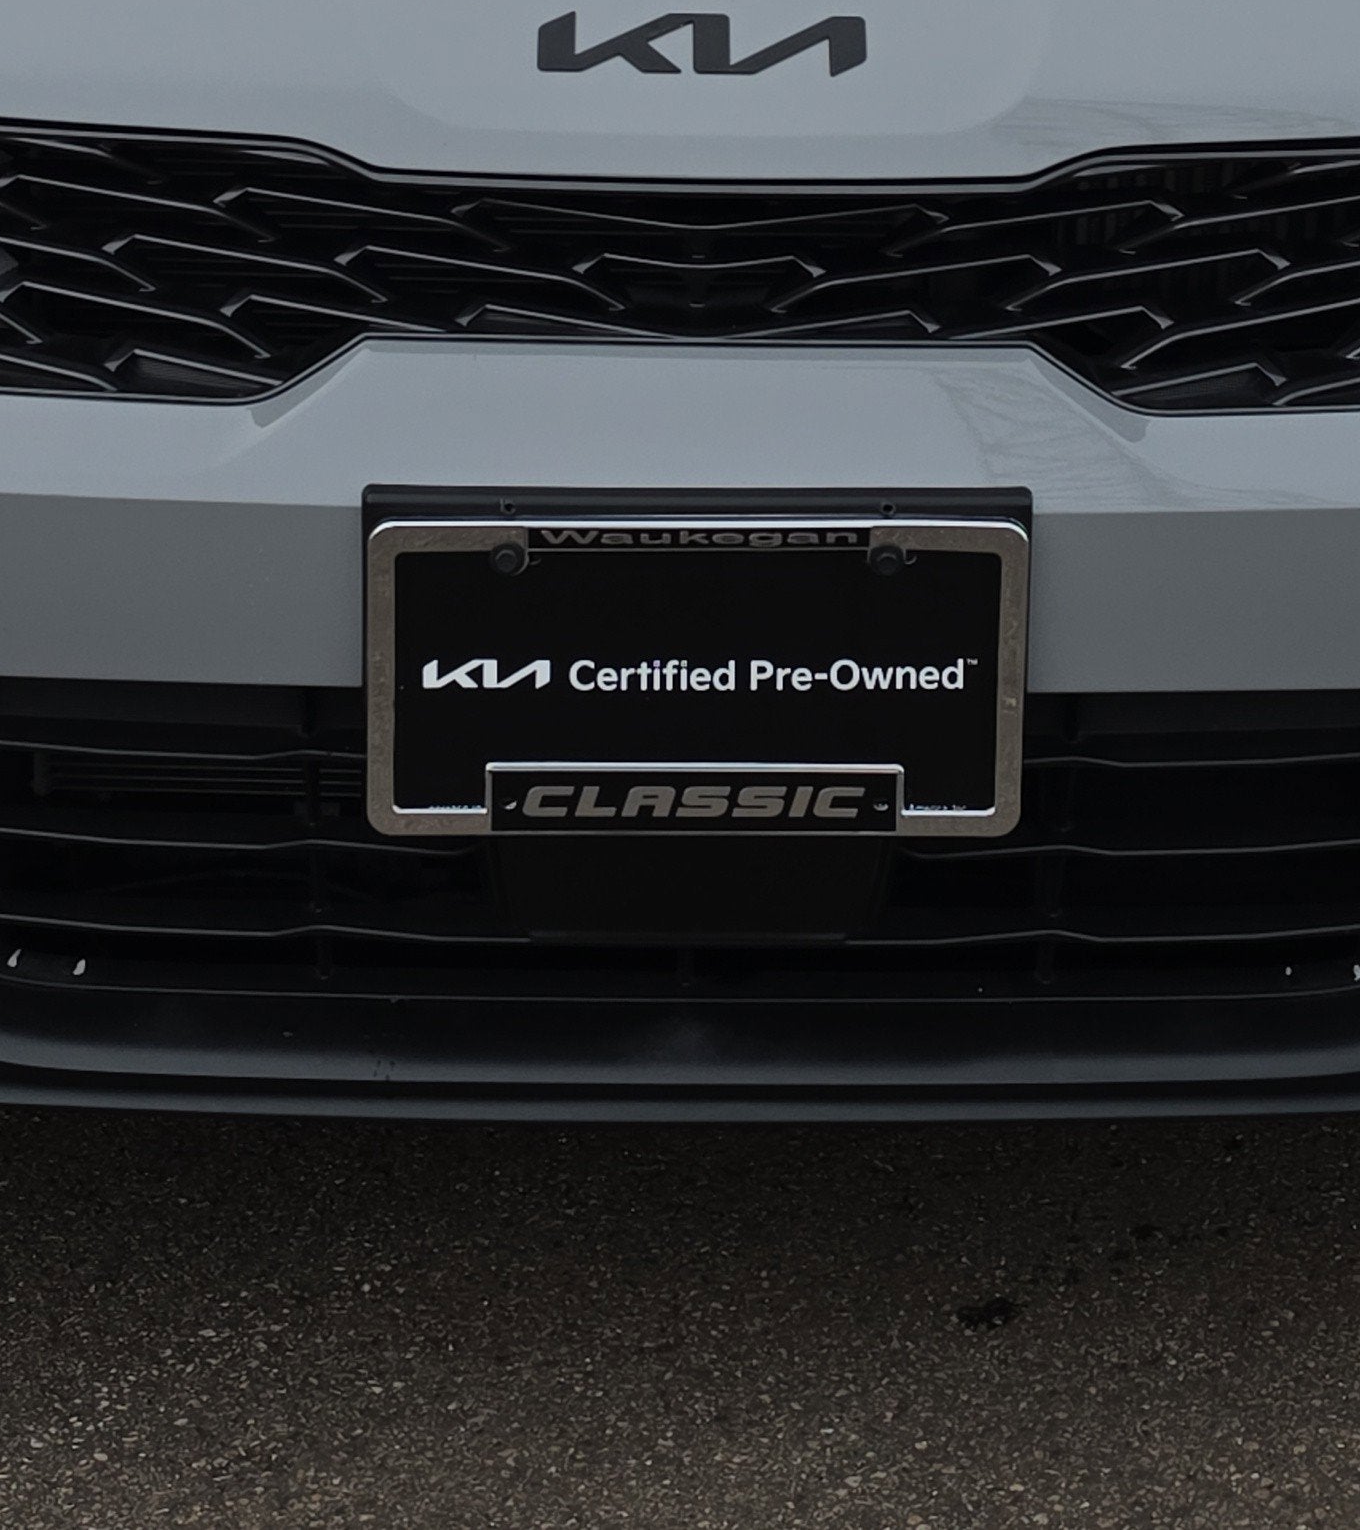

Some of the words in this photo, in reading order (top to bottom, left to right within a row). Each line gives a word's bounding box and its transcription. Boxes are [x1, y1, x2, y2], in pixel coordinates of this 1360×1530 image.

[537, 10, 867, 77] KIA
[422, 658, 551, 689] KIA
[568, 659, 736, 691] Certified
[522, 785, 866, 818] CLASSIC
